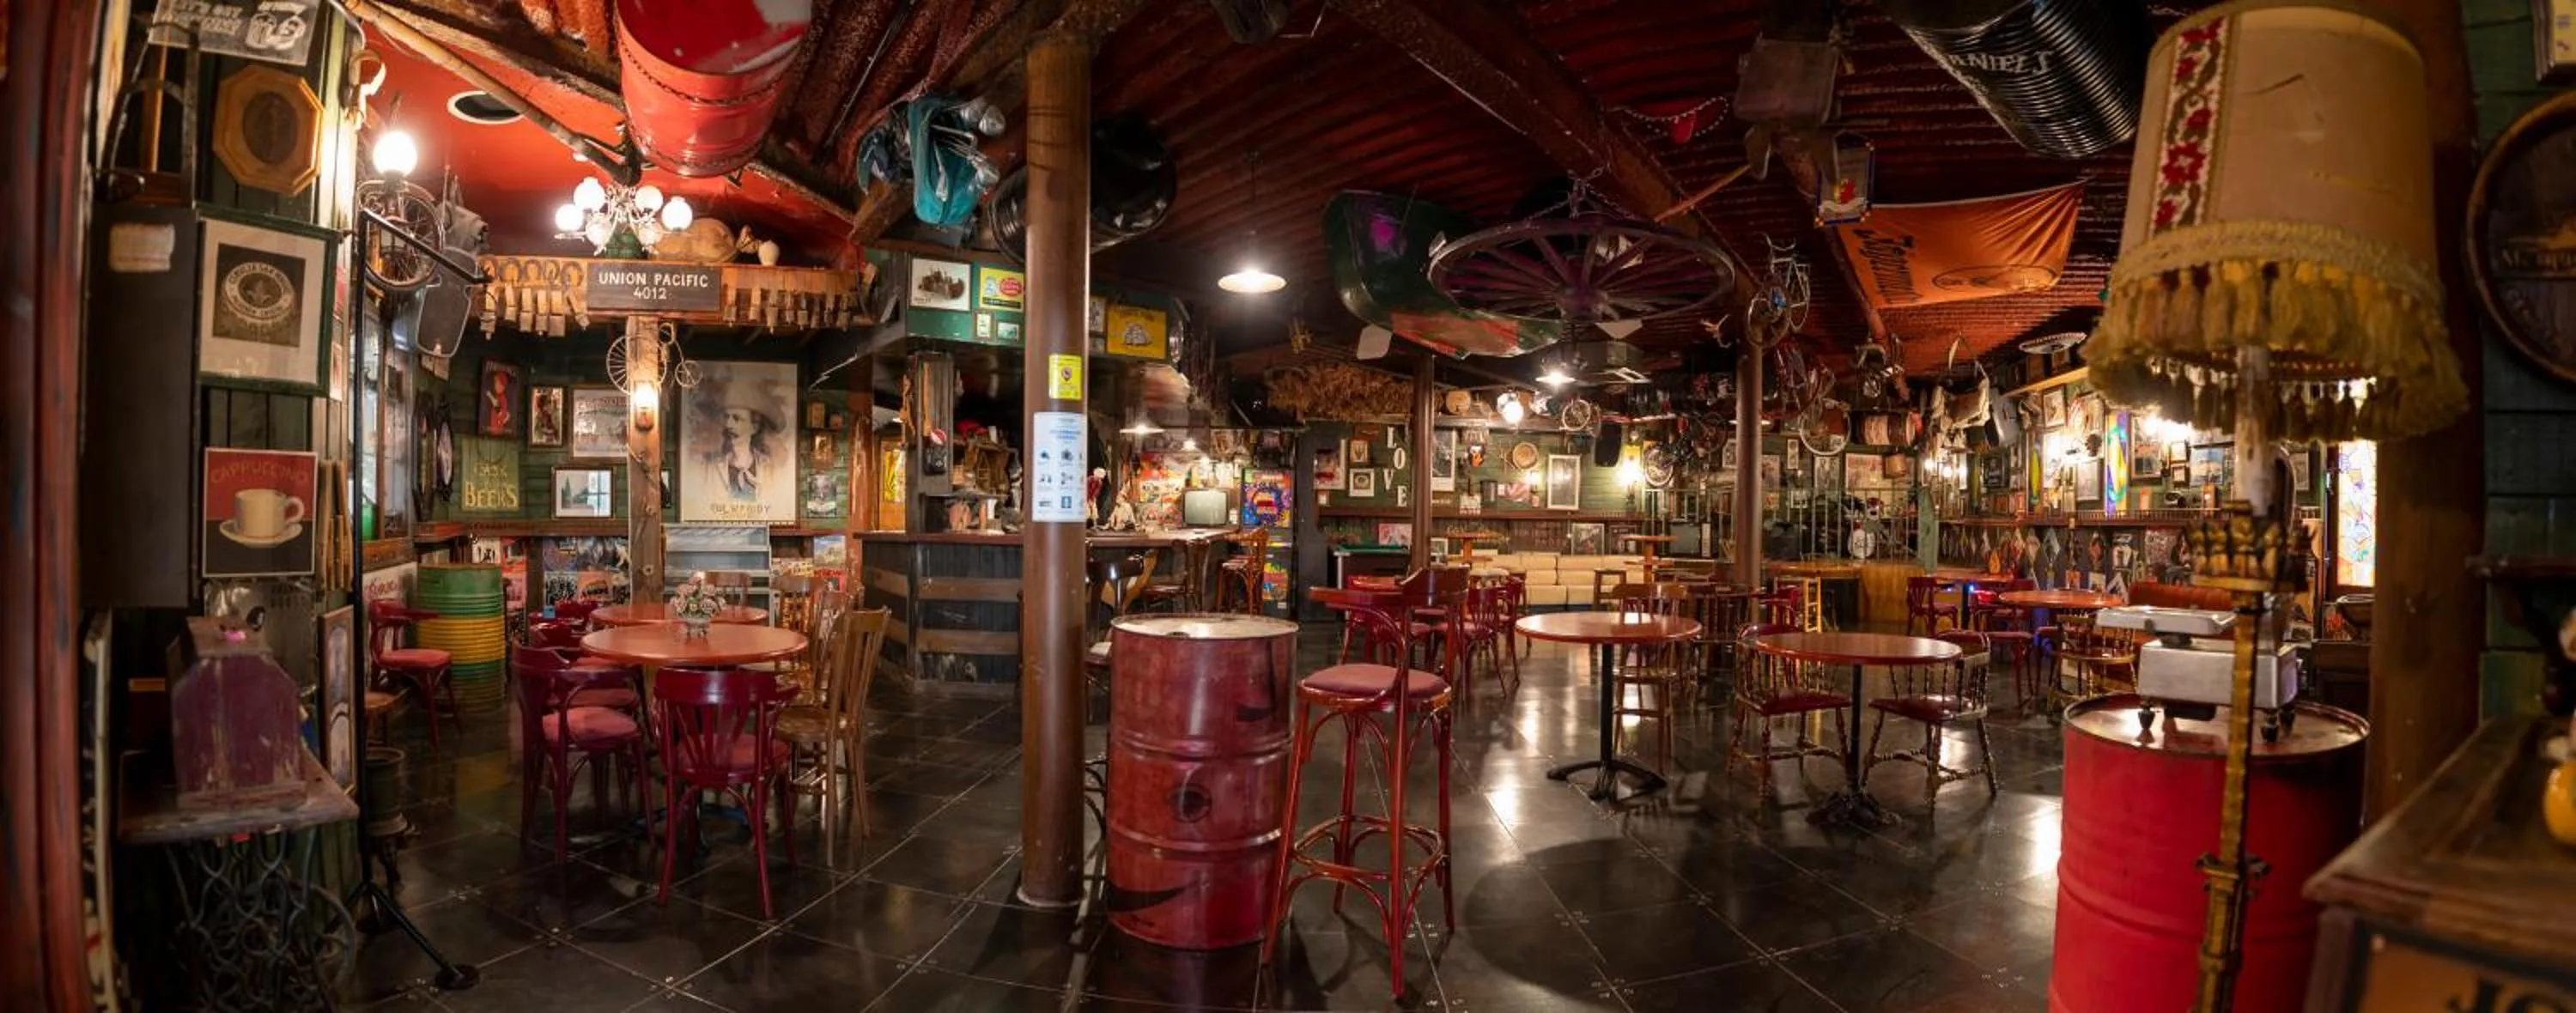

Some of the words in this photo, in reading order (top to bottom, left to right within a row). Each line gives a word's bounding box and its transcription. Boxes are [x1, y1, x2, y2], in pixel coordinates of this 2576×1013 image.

[598, 272, 647, 286] UNION
[654, 273, 708, 288] PACIFIC
[633, 287, 667, 300] 4012
[210, 461, 307, 482] CAPPUCCINO
[465, 481, 518, 507] BEERS
